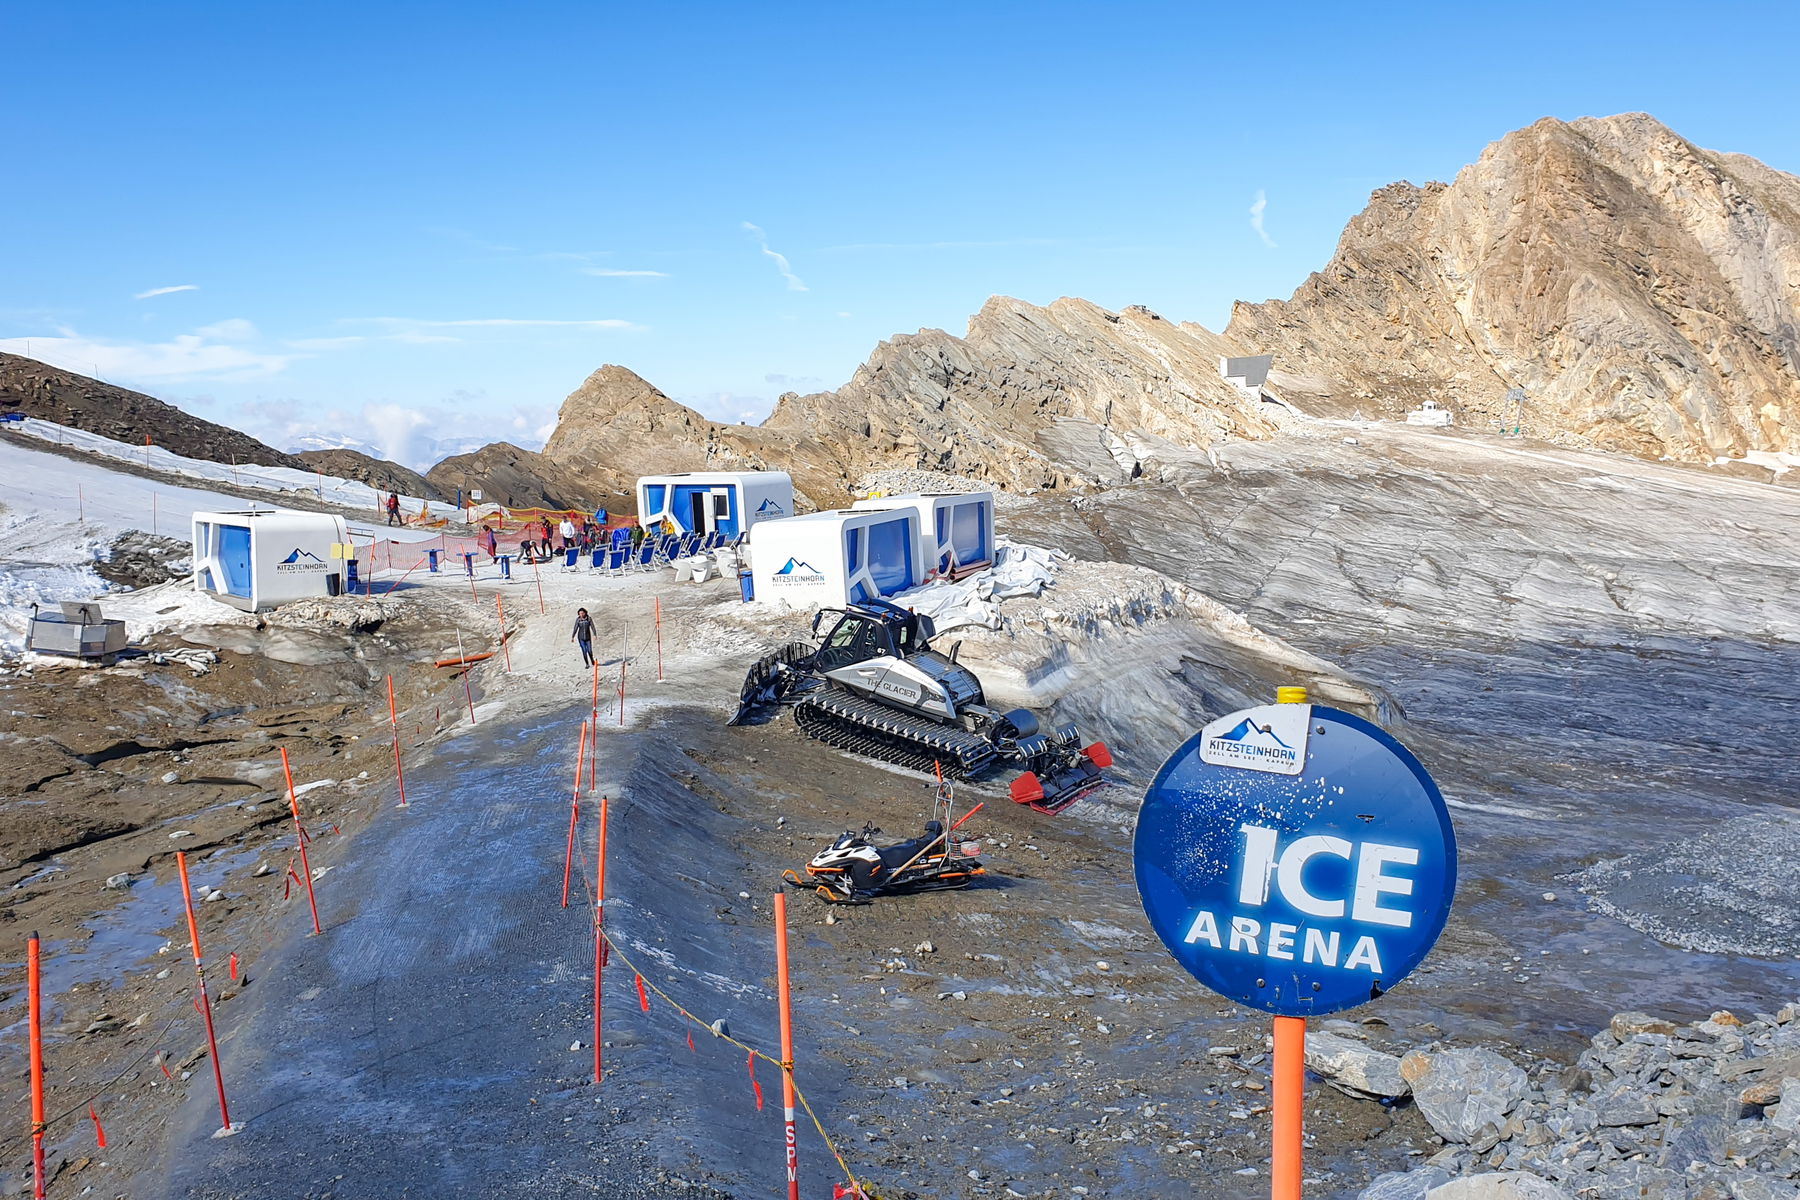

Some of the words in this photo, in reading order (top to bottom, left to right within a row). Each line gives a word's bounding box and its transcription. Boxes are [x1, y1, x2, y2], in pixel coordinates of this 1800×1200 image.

[277, 563, 328, 571] KITZSTEINHORN
[866, 678, 881, 688] THE
[883, 683, 917, 699] GLACIER
[1209, 740, 1295, 760] KITZSTEINHORN
[1239, 822, 1419, 928] ICE
[1184, 910, 1383, 974] ARENA
